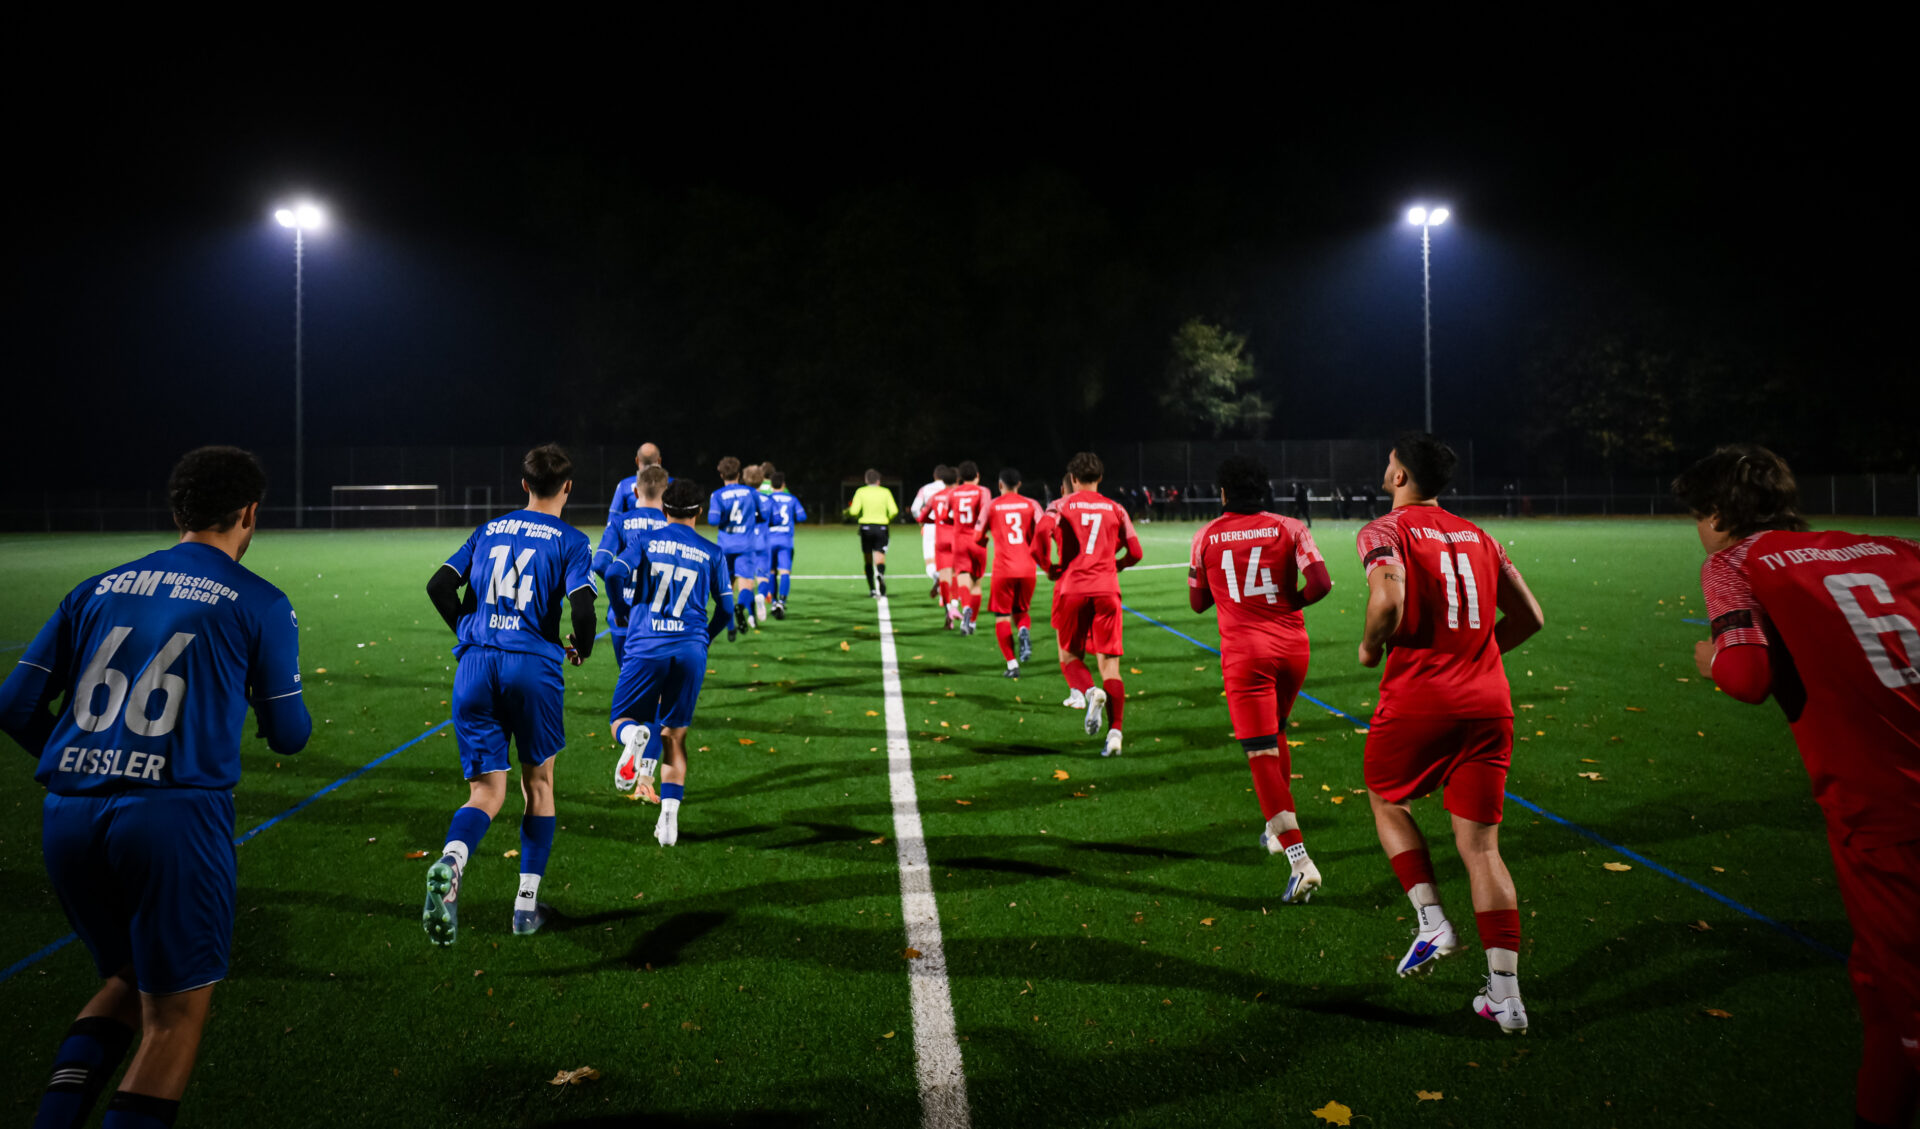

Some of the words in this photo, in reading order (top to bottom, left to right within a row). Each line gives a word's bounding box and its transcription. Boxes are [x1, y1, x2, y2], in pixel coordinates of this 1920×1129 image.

[623, 517, 648, 530] SGM
[729, 500, 743, 525] 4
[959, 498, 974, 524] 5
[485, 519, 523, 537] SGM
[1005, 512, 1024, 545] 3
[1081, 513, 1103, 555] 7
[1209, 533, 1219, 545] TV
[1220, 526, 1279, 543] DERENDINGEN
[1409, 527, 1422, 540] TV
[648, 539, 678, 556] SGM
[1758, 552, 1787, 571] TV
[1783, 541, 1897, 565] DERENDINGEN
[94, 570, 165, 596] SGM
[161, 571, 239, 602] Mössingen
[486, 545, 537, 612] 14
[651, 562, 699, 618] 77
[1221, 546, 1280, 605] 14
[1440, 551, 1481, 629] 11
[168, 585, 220, 606] Belsen
[488, 613, 521, 631] BUCK
[651, 618, 685, 632] YILDIZ
[1822, 572, 1920, 689] 6
[73, 625, 197, 738] 66
[58, 746, 166, 781] EISSLER
